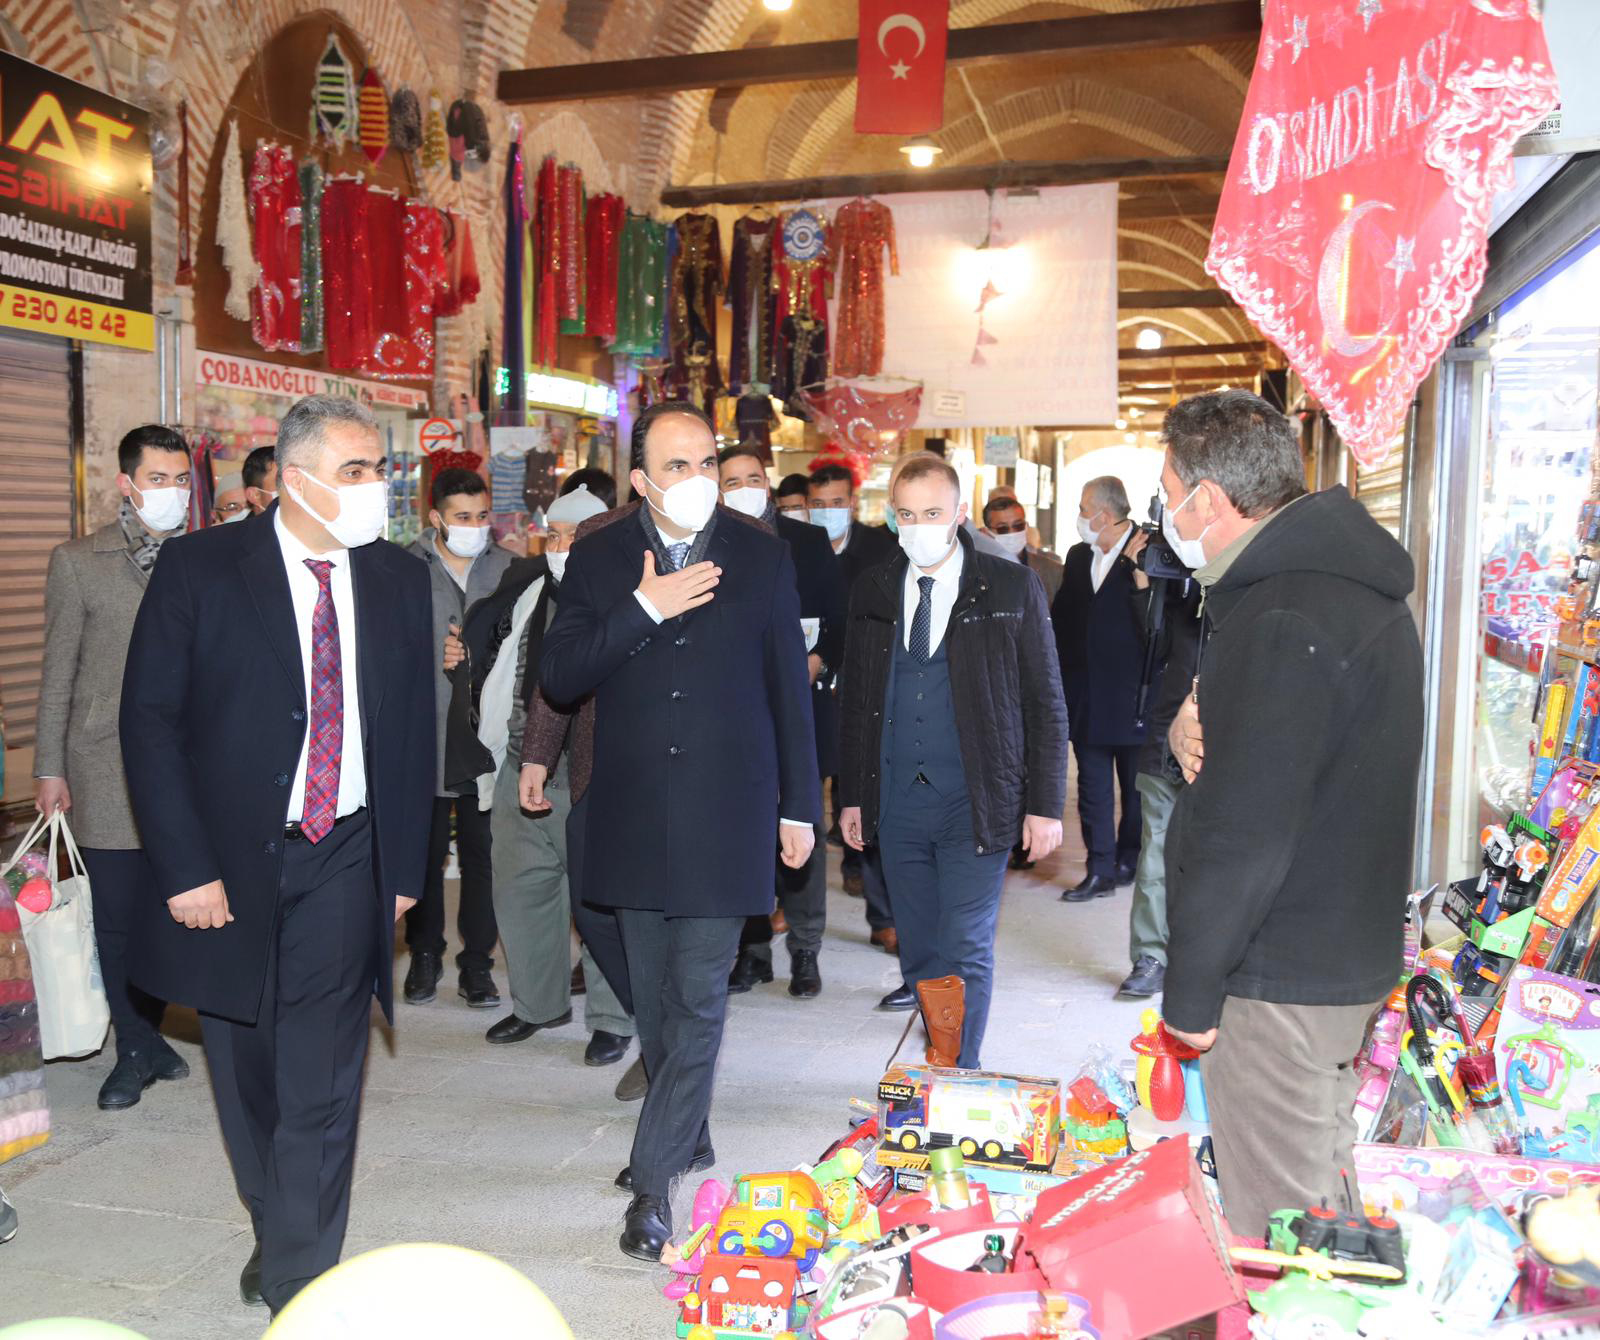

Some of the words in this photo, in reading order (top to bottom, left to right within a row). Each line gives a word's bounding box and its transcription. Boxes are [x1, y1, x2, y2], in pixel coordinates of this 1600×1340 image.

[0, 80, 136, 170] AT
[0, 250, 68, 288] ROMOSYON
[12, 293, 58, 323] 230
[65, 305, 94, 330] 48
[100, 312, 126, 338] 42
[201, 357, 316, 396] ÇOBANOĞLU
[880, 1085, 912, 1097] TRUCK
